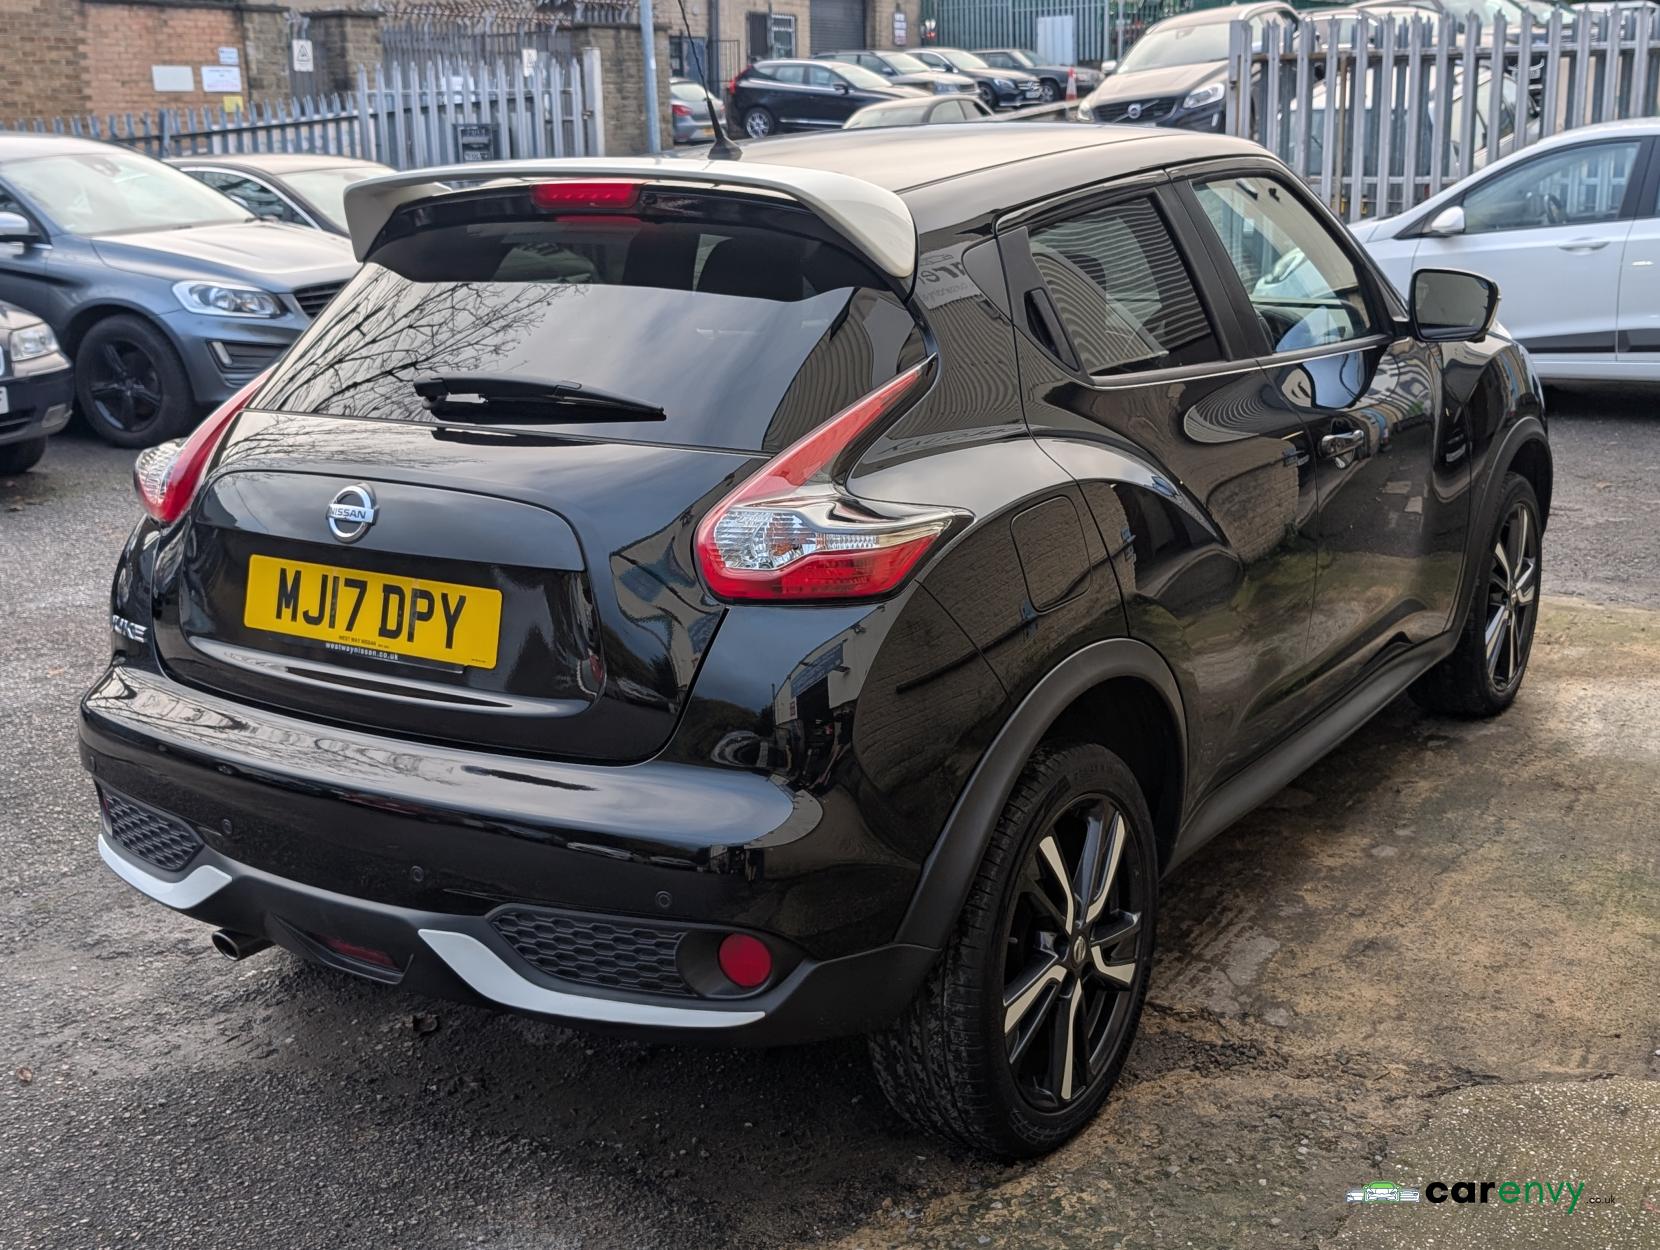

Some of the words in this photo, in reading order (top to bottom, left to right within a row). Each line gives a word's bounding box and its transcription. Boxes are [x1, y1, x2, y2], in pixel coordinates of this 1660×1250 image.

[329, 506, 366, 520] NISSAN
[275, 567, 369, 632] MJ17
[377, 583, 467, 650] DPY
